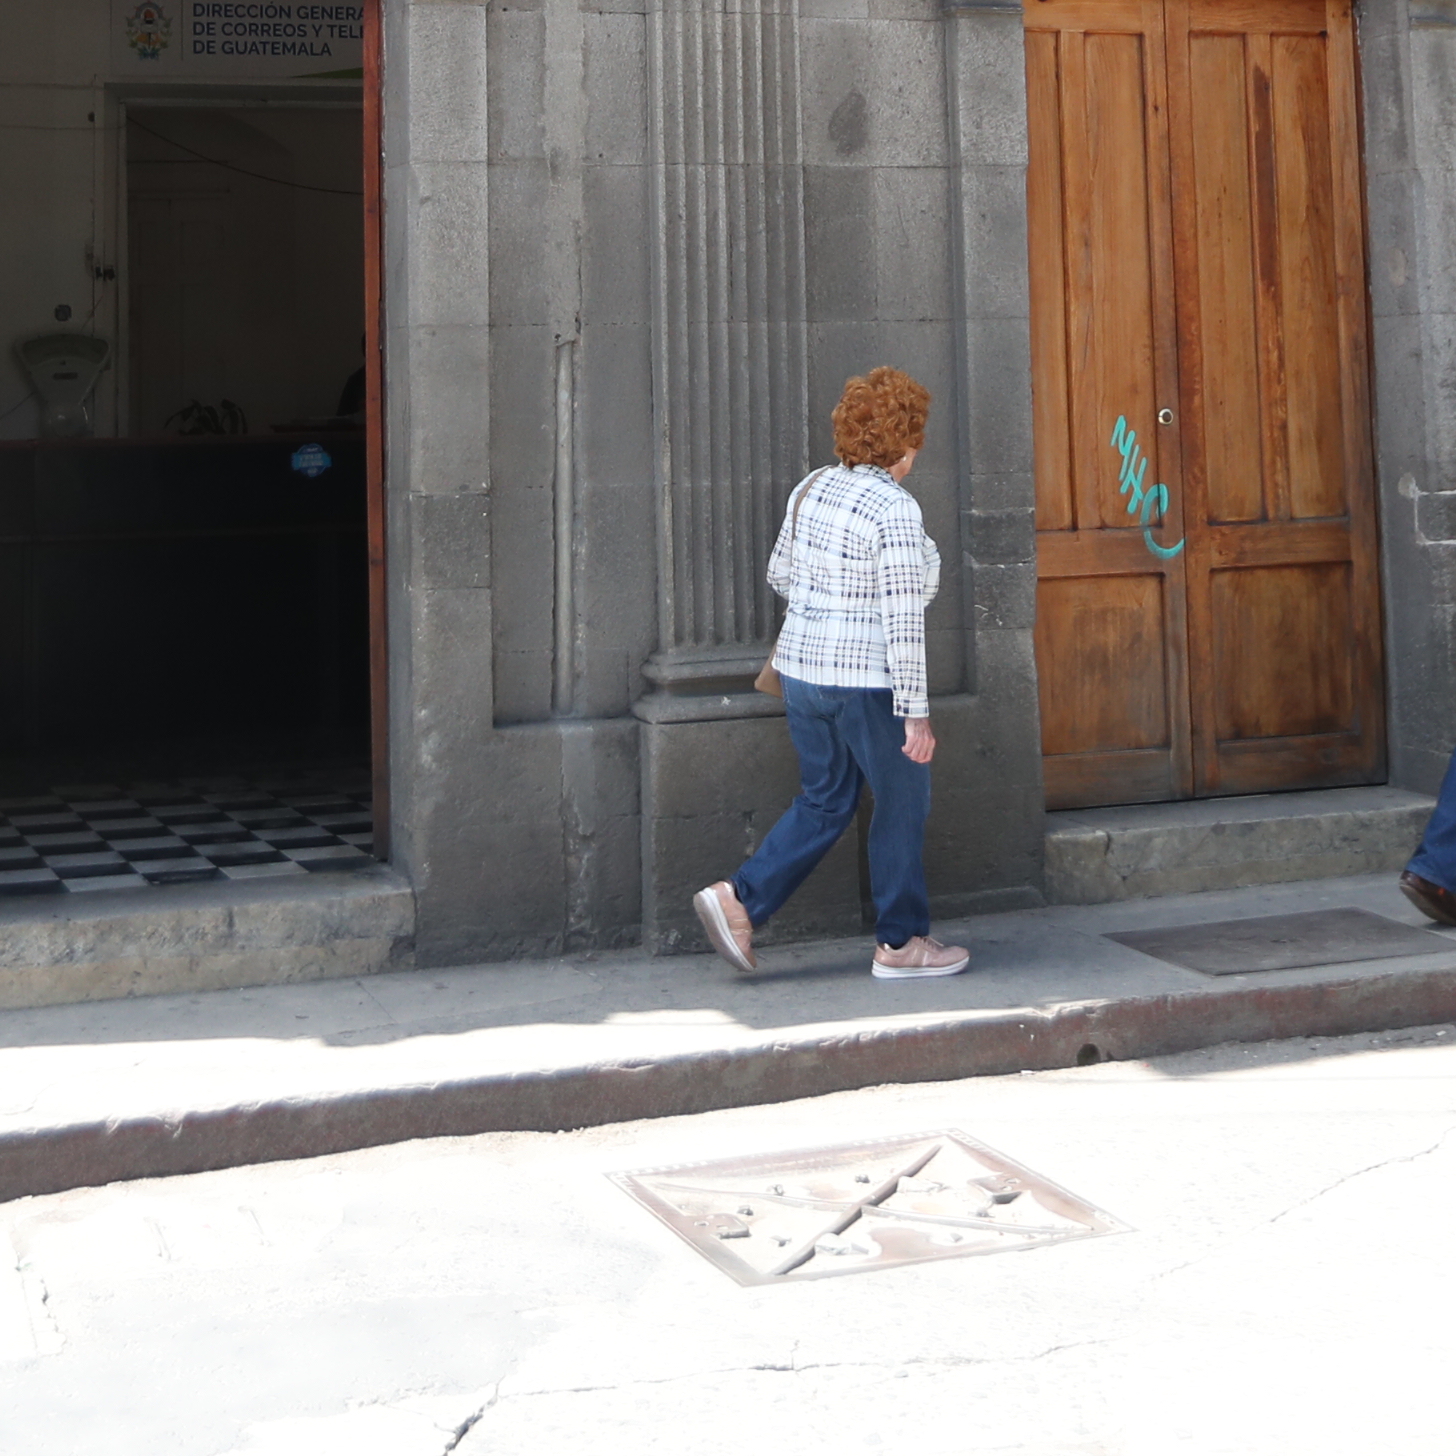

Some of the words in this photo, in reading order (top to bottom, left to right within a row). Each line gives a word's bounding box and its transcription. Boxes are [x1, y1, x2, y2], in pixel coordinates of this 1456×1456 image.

[192, 1, 292, 20] DIRECCIÓN
[192, 21, 217, 36] DE
[221, 22, 308, 38] CORREOS
[311, 23, 323, 38] Y
[192, 40, 217, 55] DE
[221, 40, 332, 56] GUATEMALA
